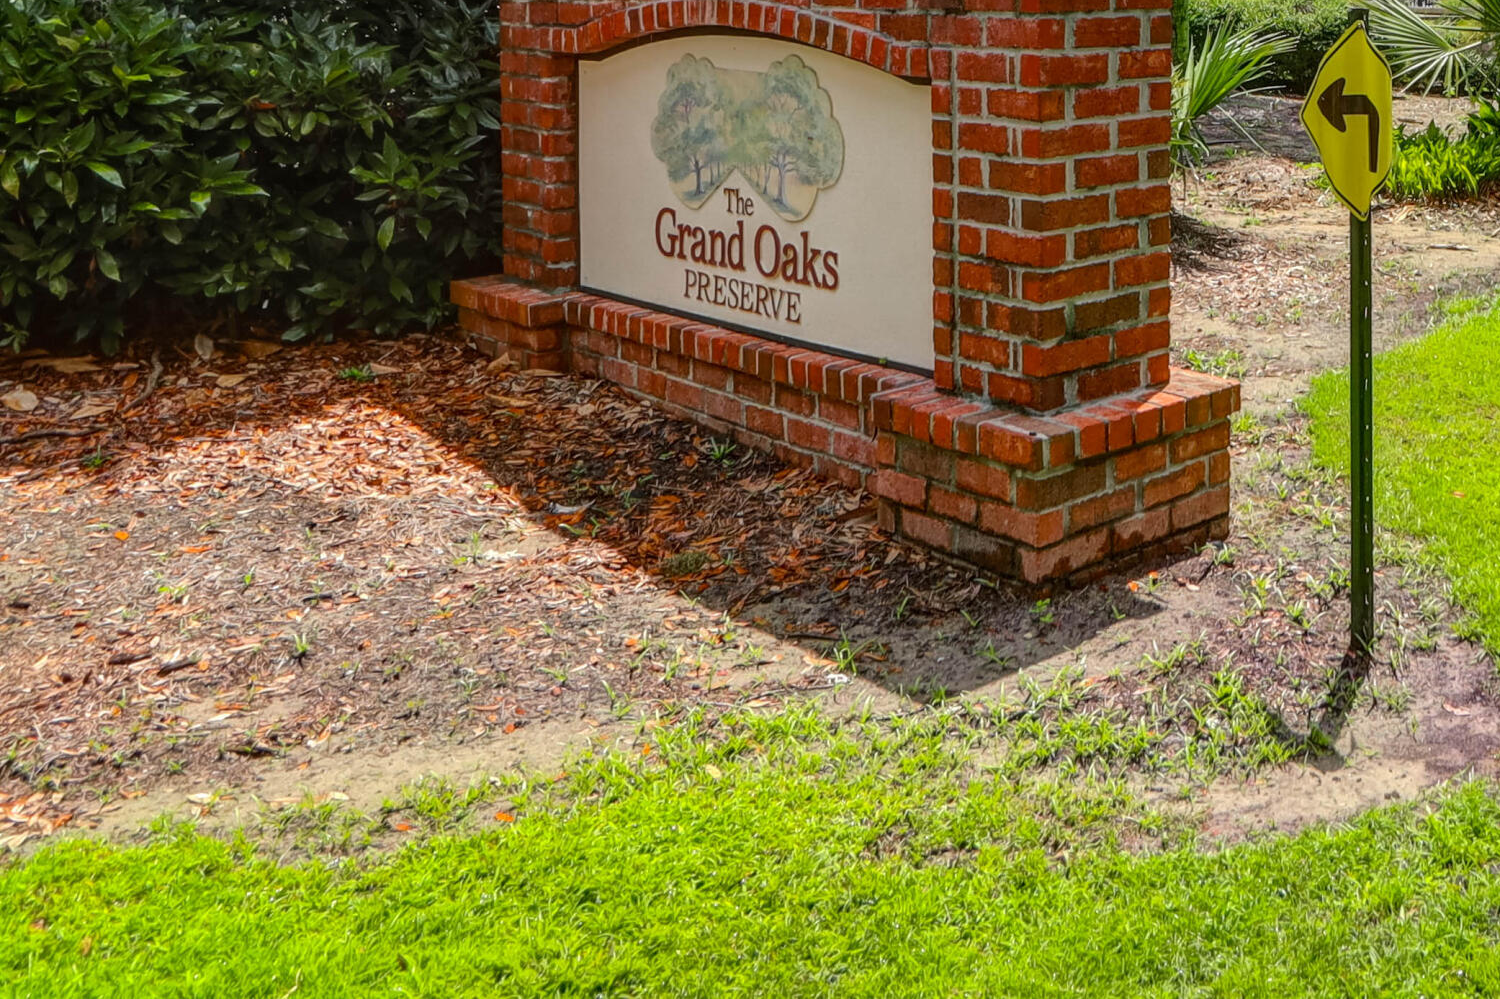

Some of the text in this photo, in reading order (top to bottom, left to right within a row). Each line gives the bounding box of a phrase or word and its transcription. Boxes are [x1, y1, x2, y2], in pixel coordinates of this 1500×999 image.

[723, 188, 754, 216] The
[655, 207, 839, 291] Grand Oaks
[683, 268, 802, 325] PRESERVE
